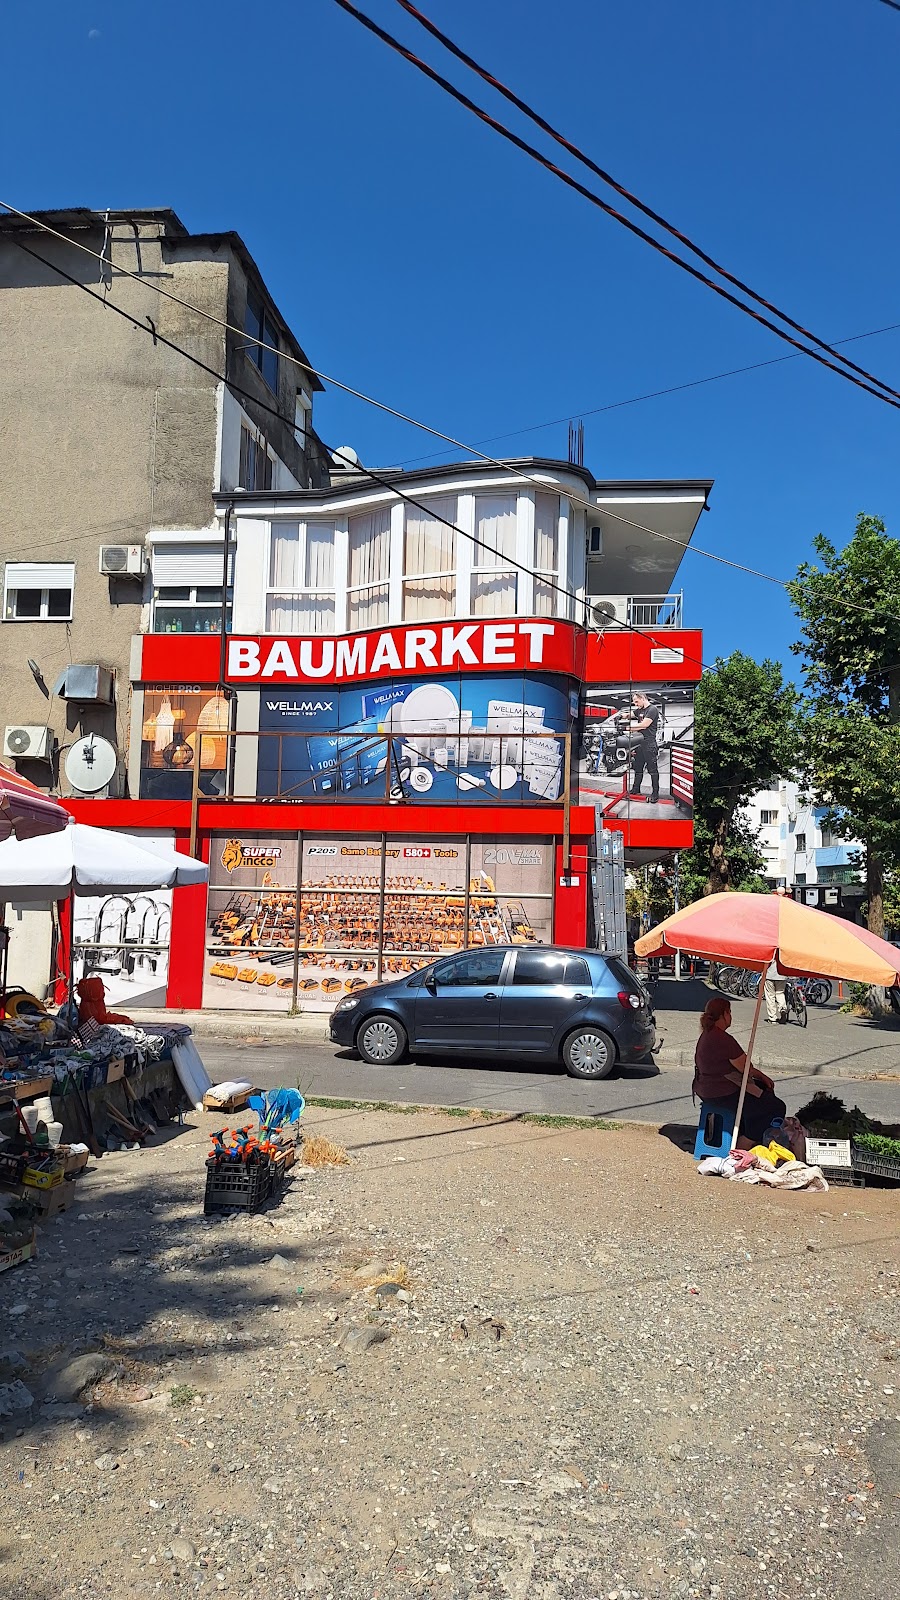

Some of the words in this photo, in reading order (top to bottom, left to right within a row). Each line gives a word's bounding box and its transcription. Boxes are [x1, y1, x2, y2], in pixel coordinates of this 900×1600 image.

[228, 623, 555, 678] BAUMARKET
[265, 701, 334, 711] WELLMAX
[493, 705, 537, 718] WELLMAX
[243, 848, 281, 857] SUPER
[341, 847, 366, 857] Same
[405, 848, 430, 857] 580+
[434, 848, 458, 857] Tools
